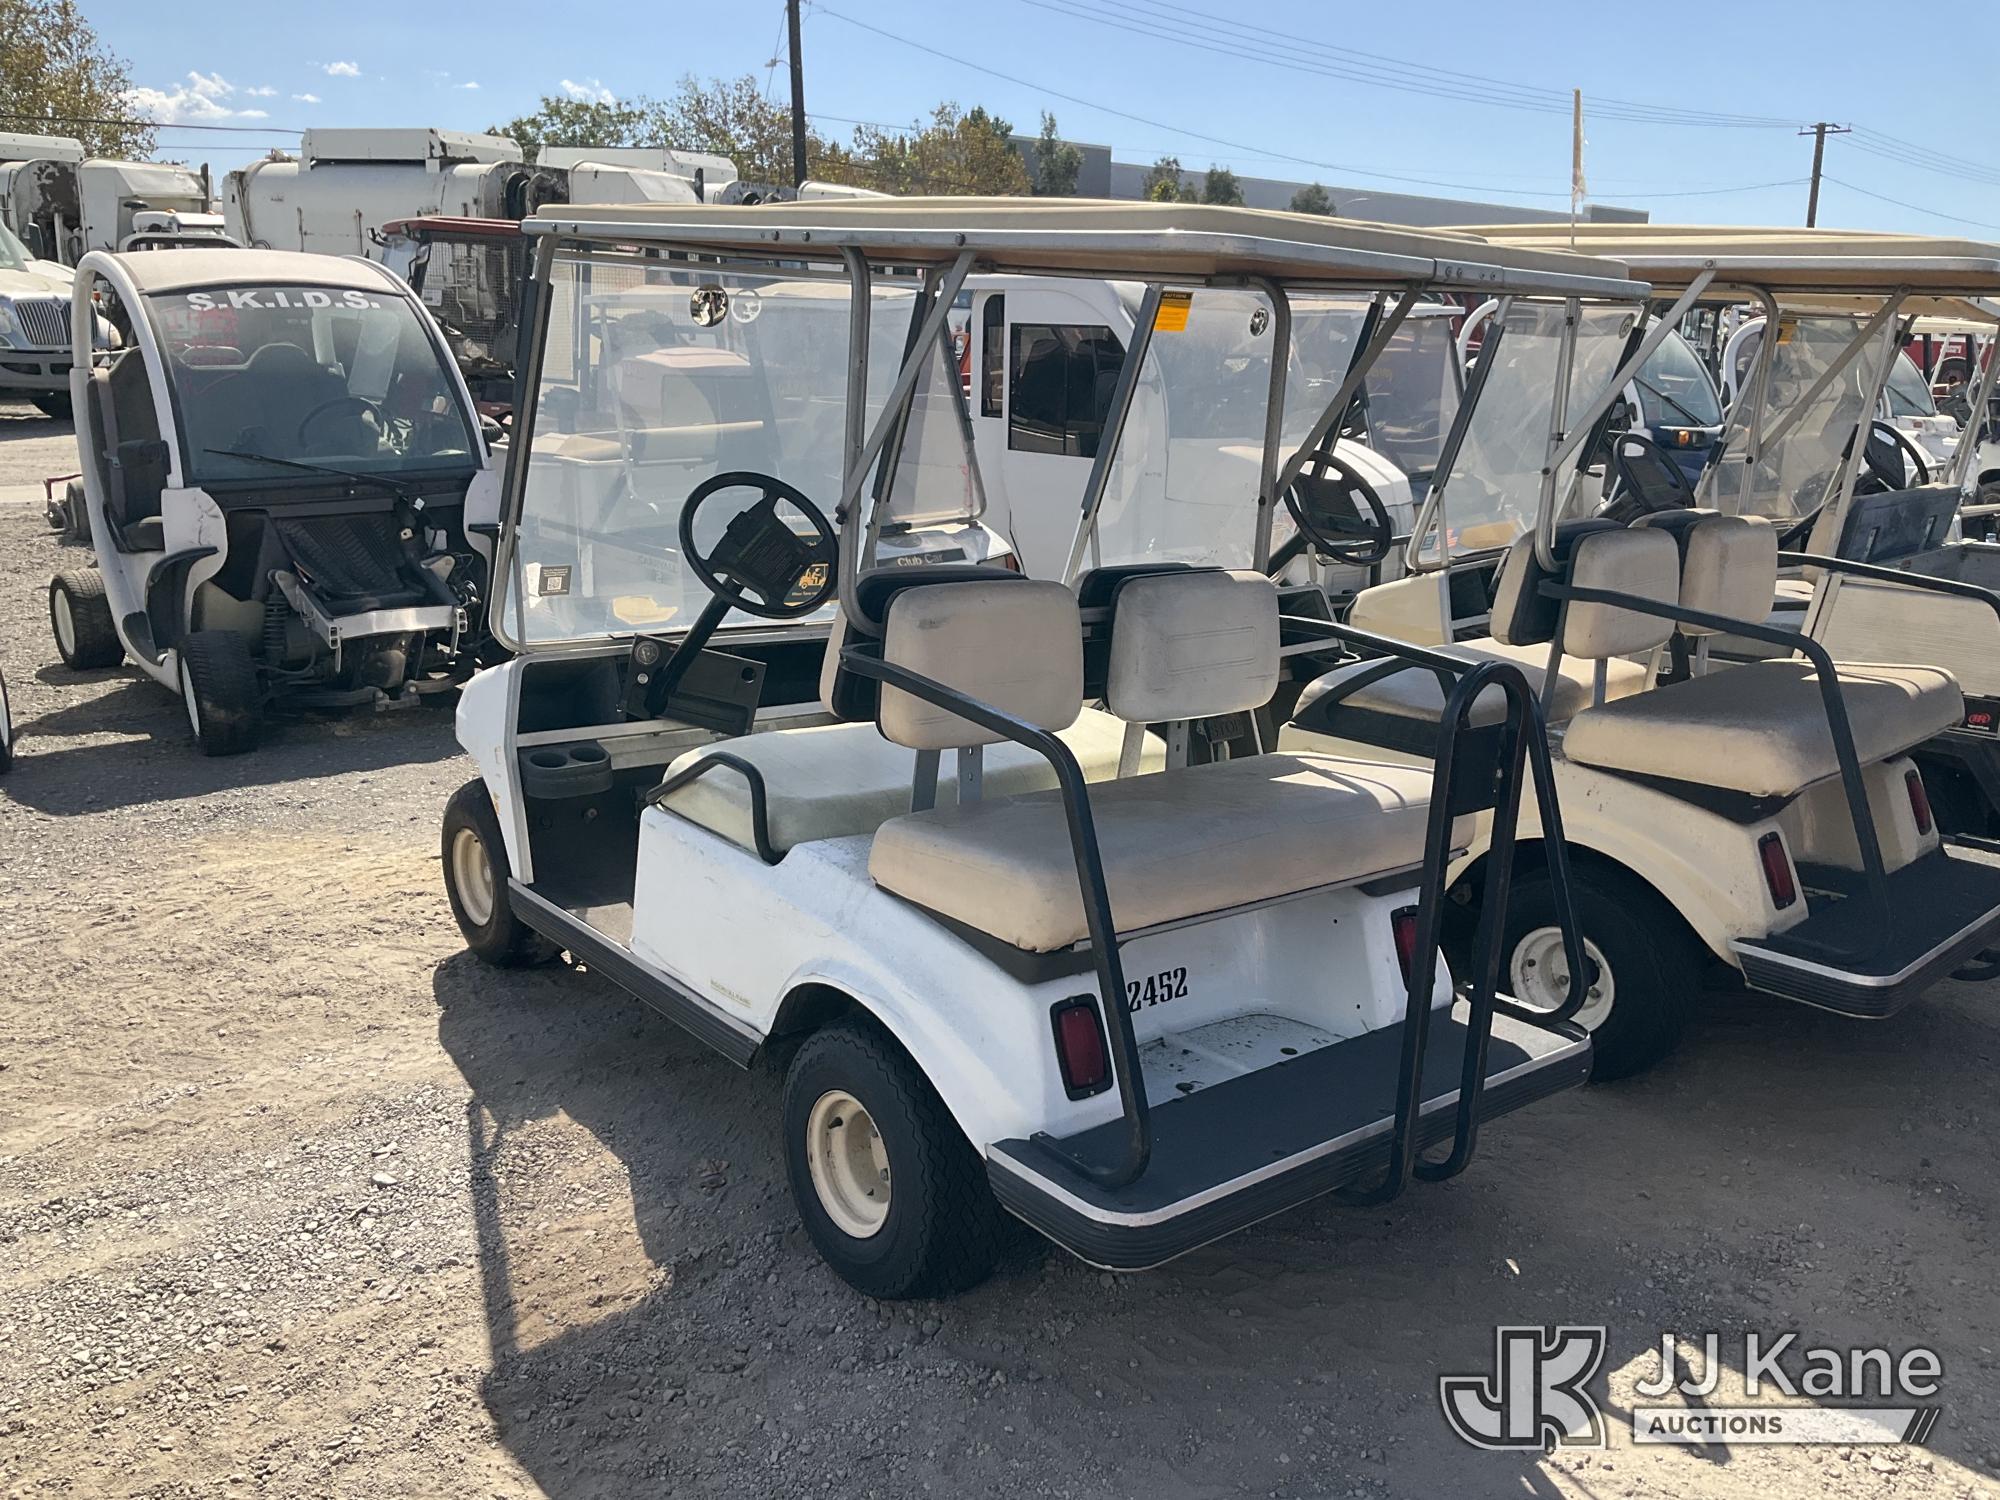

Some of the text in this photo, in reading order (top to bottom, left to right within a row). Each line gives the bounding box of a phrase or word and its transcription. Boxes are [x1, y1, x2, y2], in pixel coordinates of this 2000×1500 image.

[186, 291, 381, 311] S.K.I.D.S.
[897, 553, 943, 567] Club Car
[1127, 966, 1188, 1013] 2452
